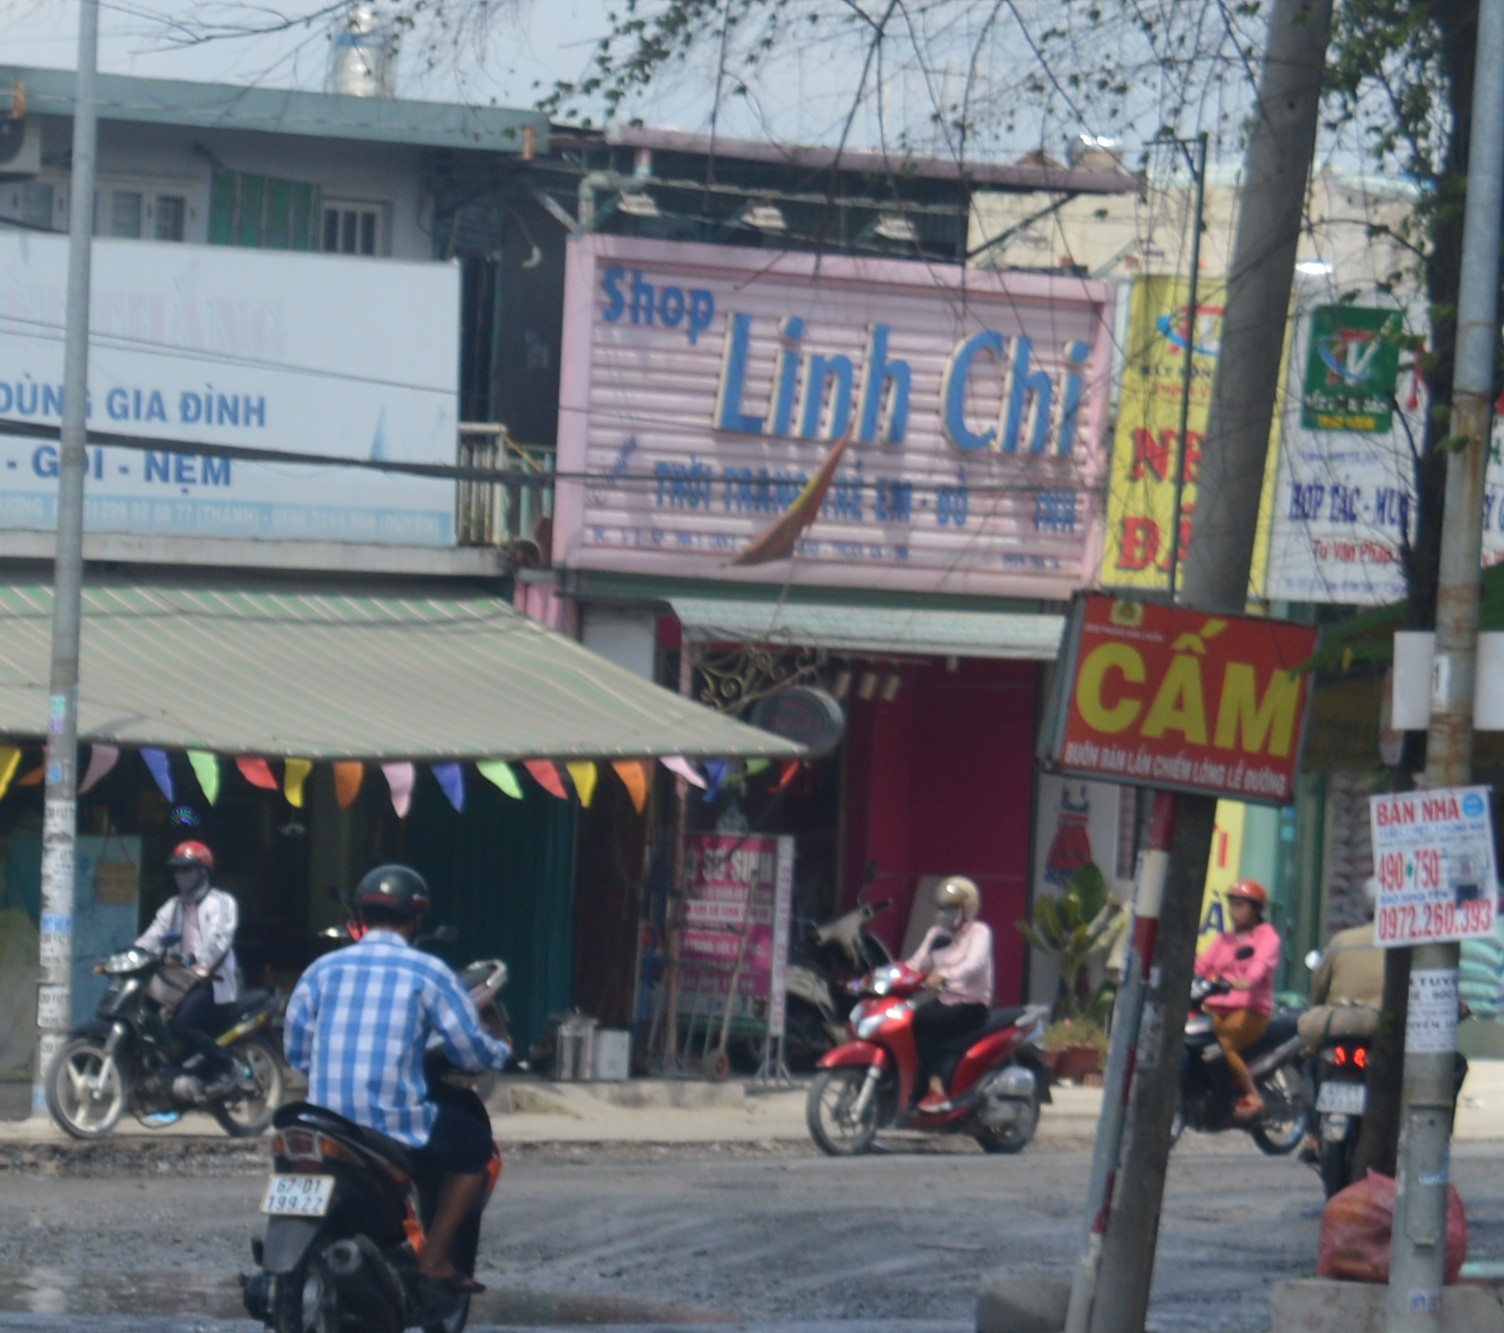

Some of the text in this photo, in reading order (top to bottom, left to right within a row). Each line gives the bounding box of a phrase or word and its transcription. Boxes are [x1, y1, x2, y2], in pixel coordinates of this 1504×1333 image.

[601, 264, 716, 344] Shop
[105, 386, 168, 424] GIA
[179, 383, 266, 429] ĐÌNH
[713, 311, 912, 444] Linh
[944, 329, 1090, 456] Chi
[31, 440, 105, 481] GI
[1076, 618, 1302, 758] CẤM
